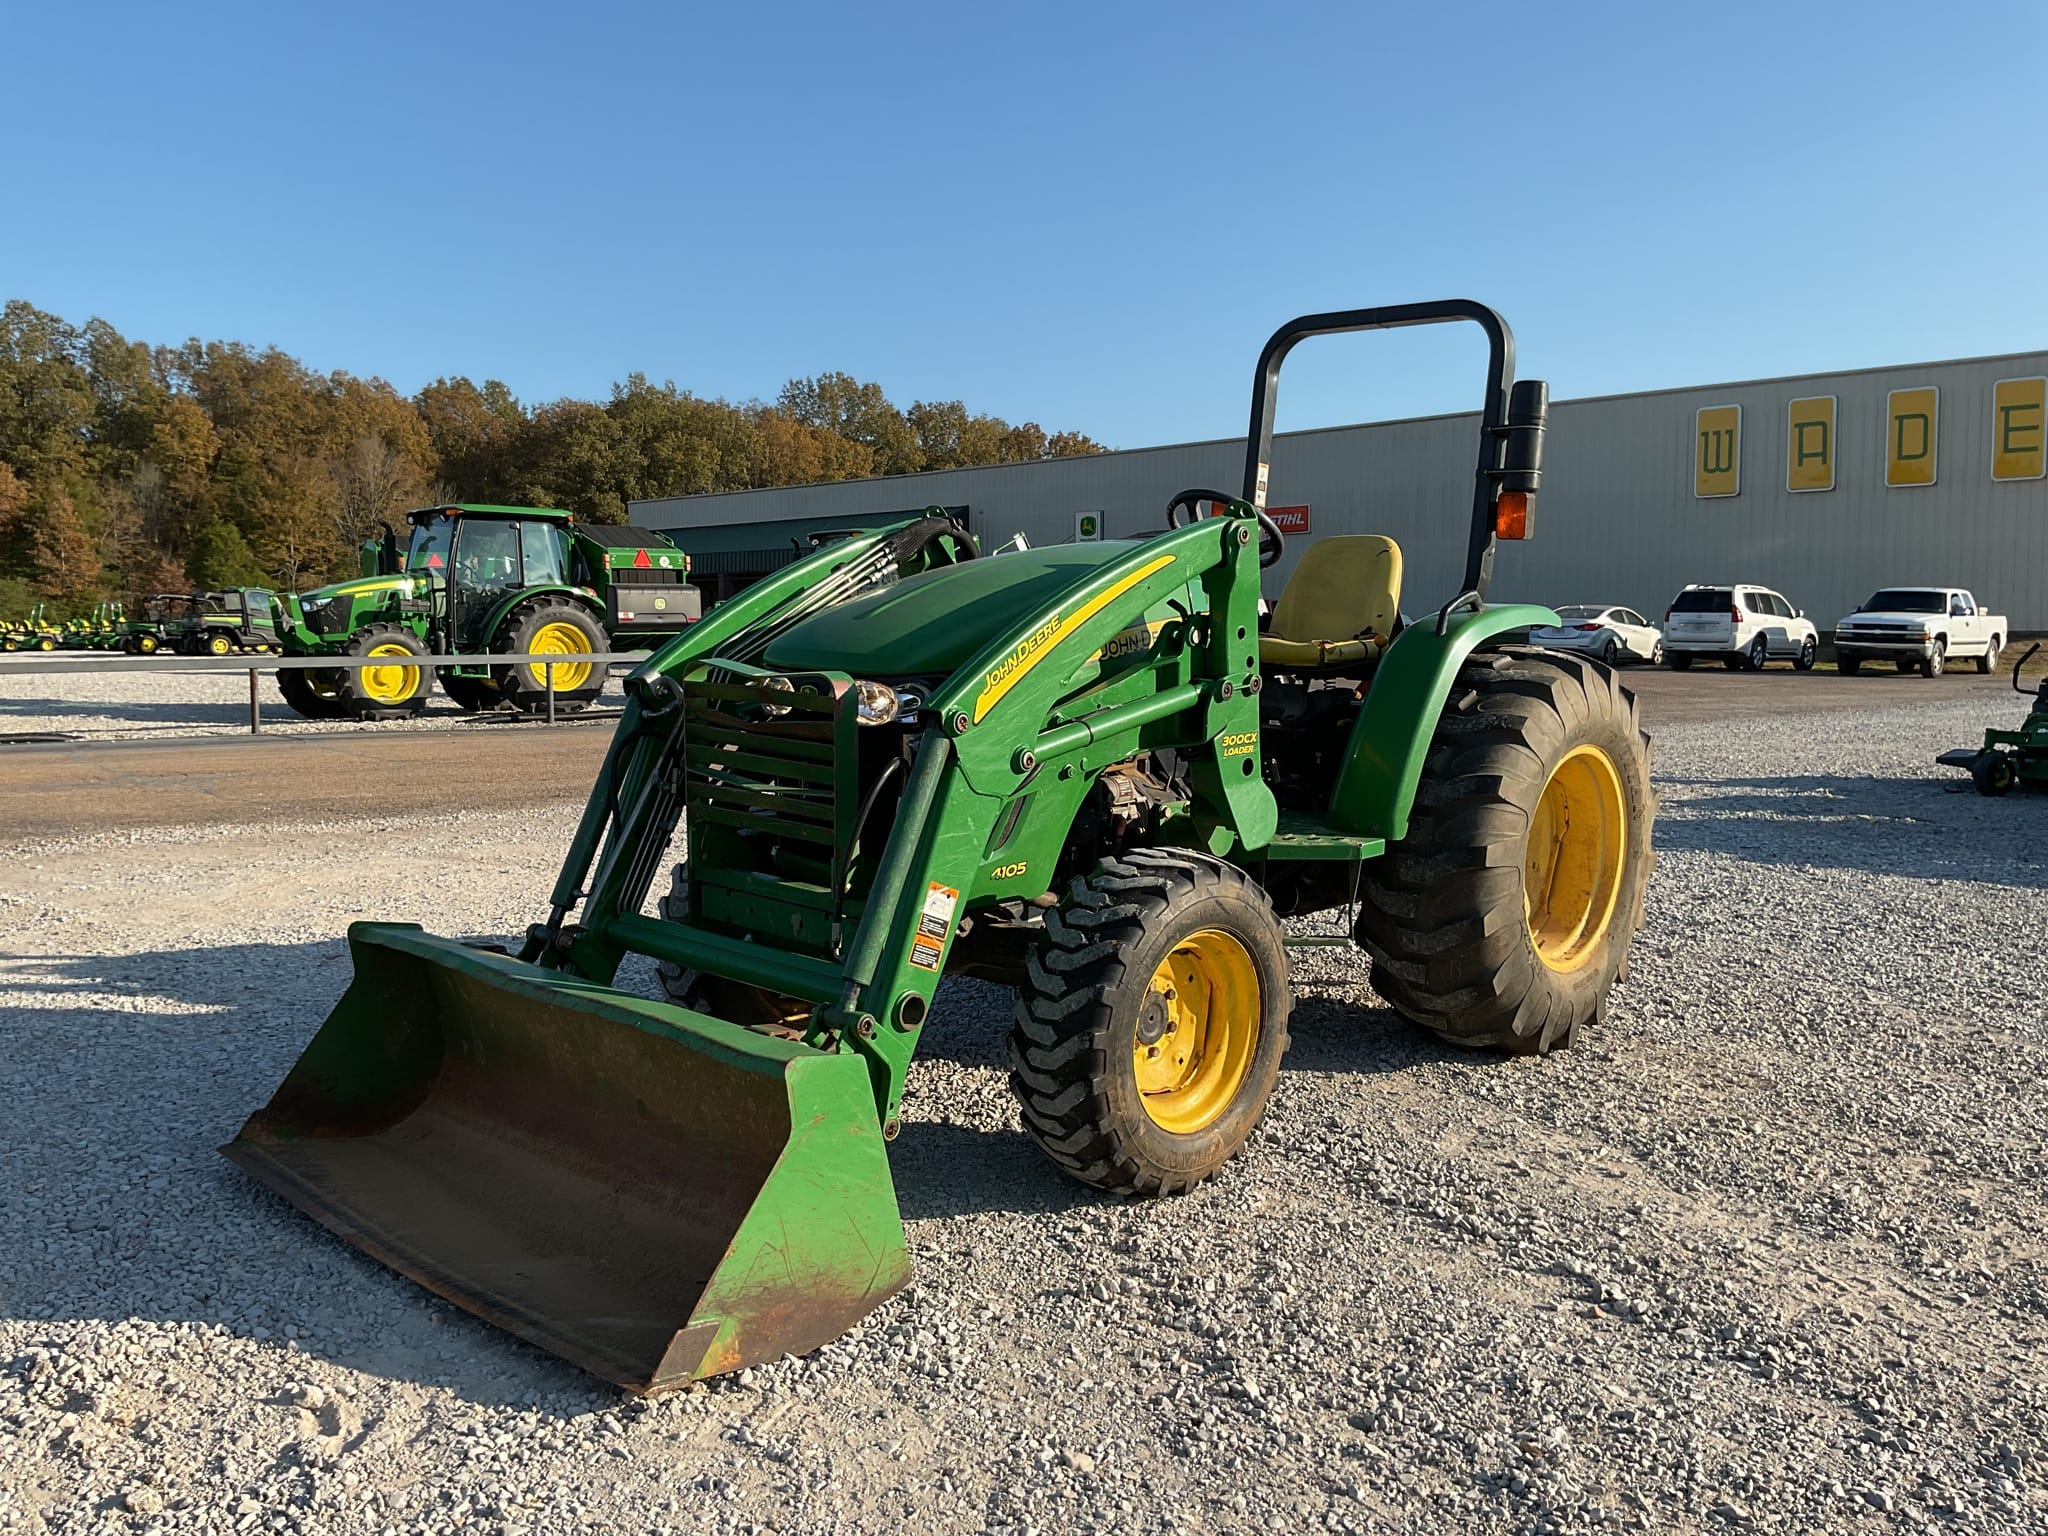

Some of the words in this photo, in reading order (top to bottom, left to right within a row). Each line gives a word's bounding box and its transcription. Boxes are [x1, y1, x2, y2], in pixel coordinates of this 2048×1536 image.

[983, 653, 1020, 695] JOHN
[1017, 614, 1062, 664] DEERE
[1099, 634, 1139, 660] JOHN
[1222, 731, 1258, 747] 300CX
[1223, 745, 1255, 758] LOADER
[990, 861, 1029, 880] 4105
